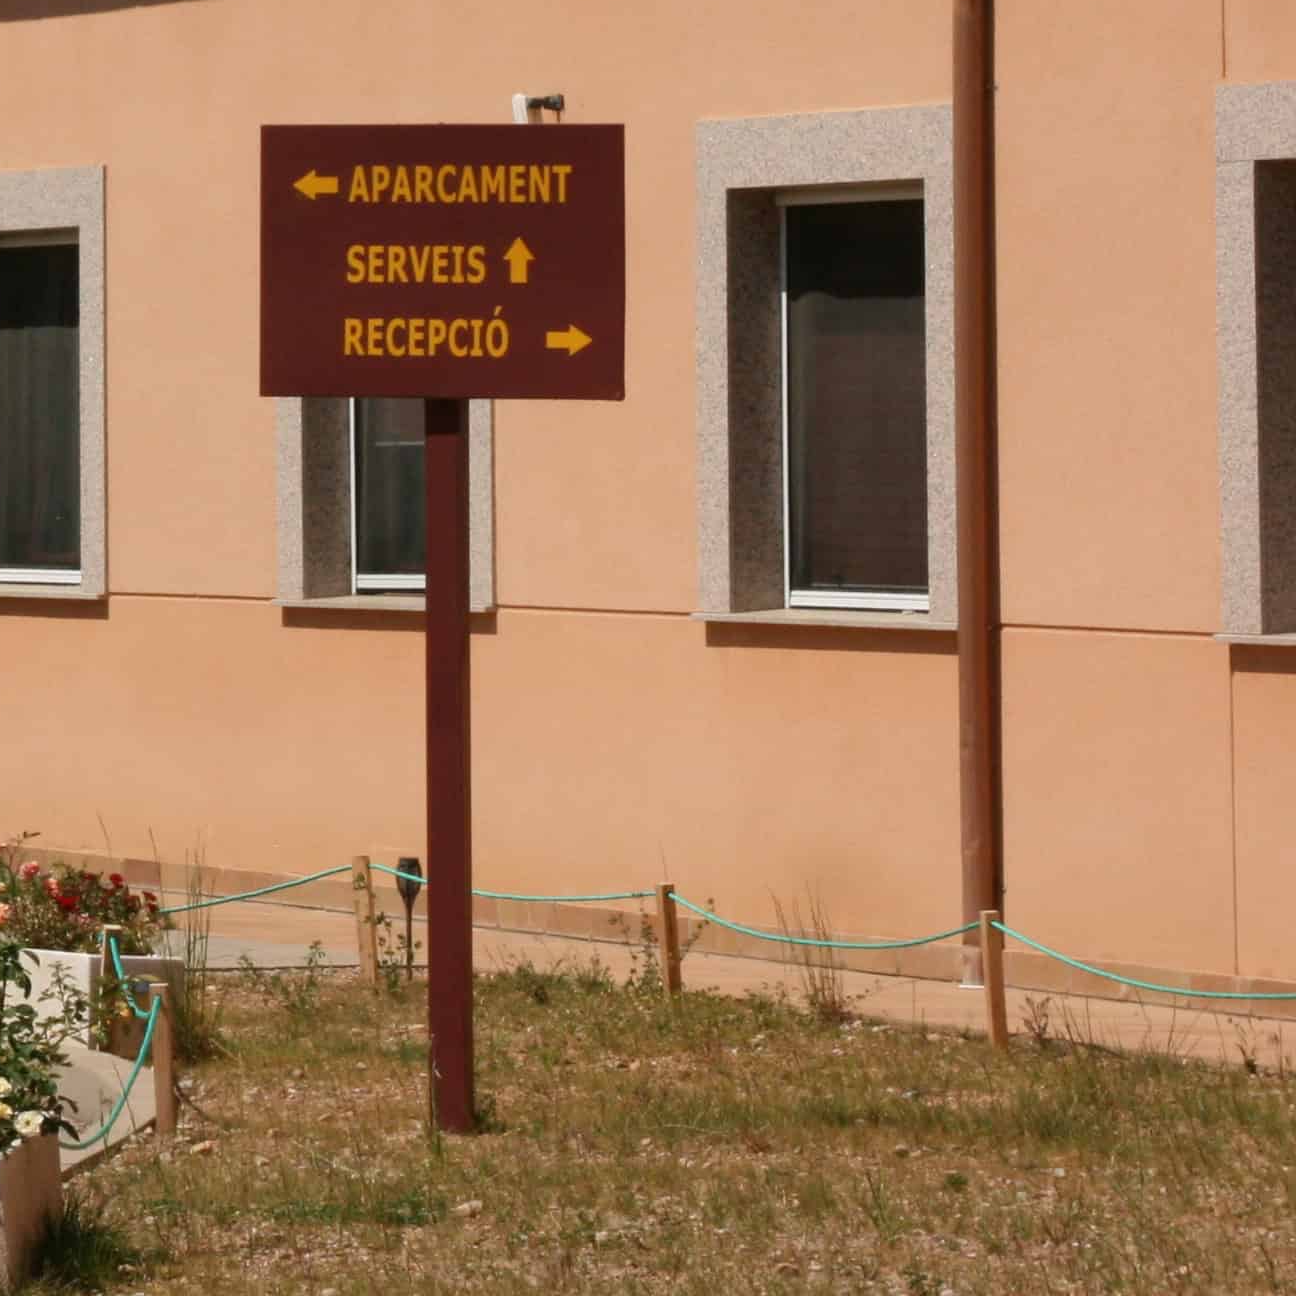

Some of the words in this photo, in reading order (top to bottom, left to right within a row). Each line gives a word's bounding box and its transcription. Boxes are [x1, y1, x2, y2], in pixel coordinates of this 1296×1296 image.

[348, 165, 572, 203] APARCAMENT
[346, 245, 486, 283] SERVEIS
[343, 305, 509, 357] RECEPCIÓ
